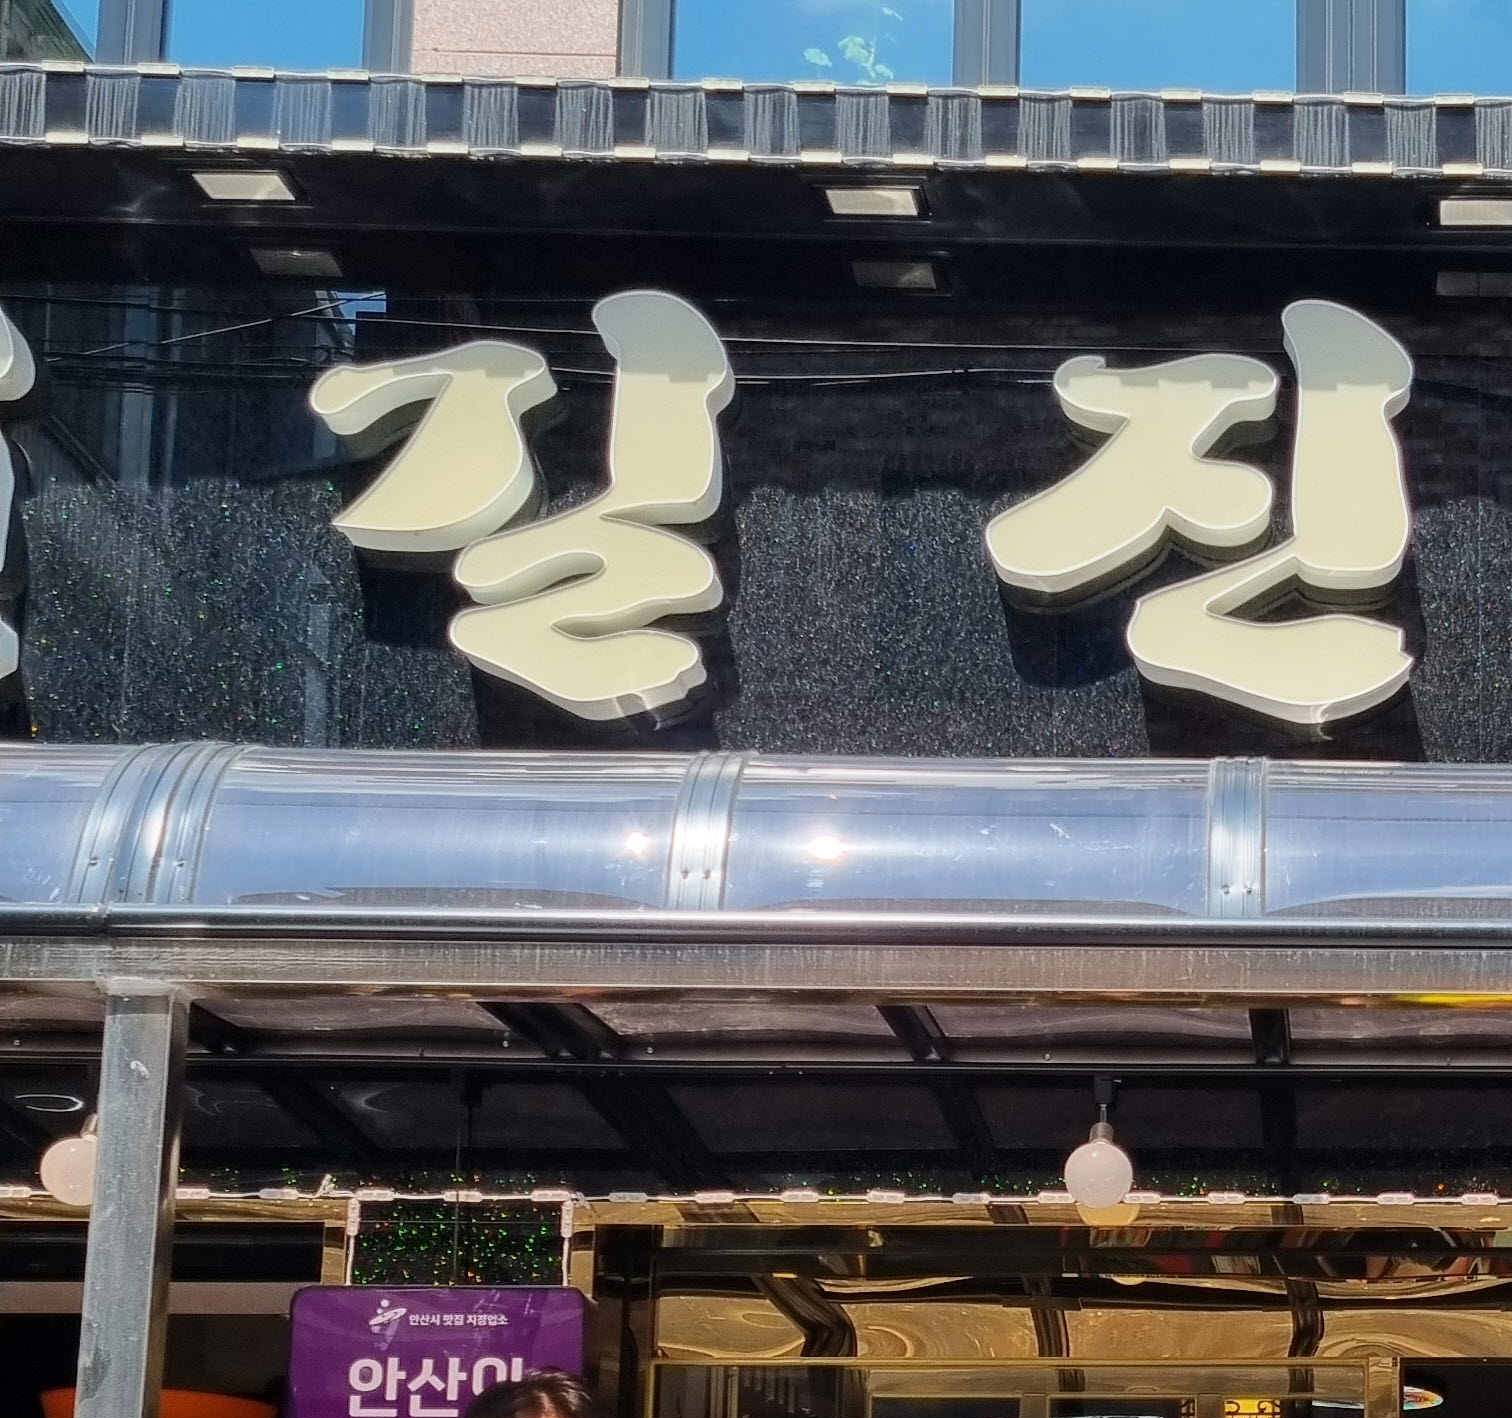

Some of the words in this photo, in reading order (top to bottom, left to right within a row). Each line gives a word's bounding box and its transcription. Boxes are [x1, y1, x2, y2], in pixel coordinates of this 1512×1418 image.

[409, 1314, 440, 1326] 안산시
[443, 1314, 464, 1326] 맛집
[466, 1314, 509, 1326] 지정업소
